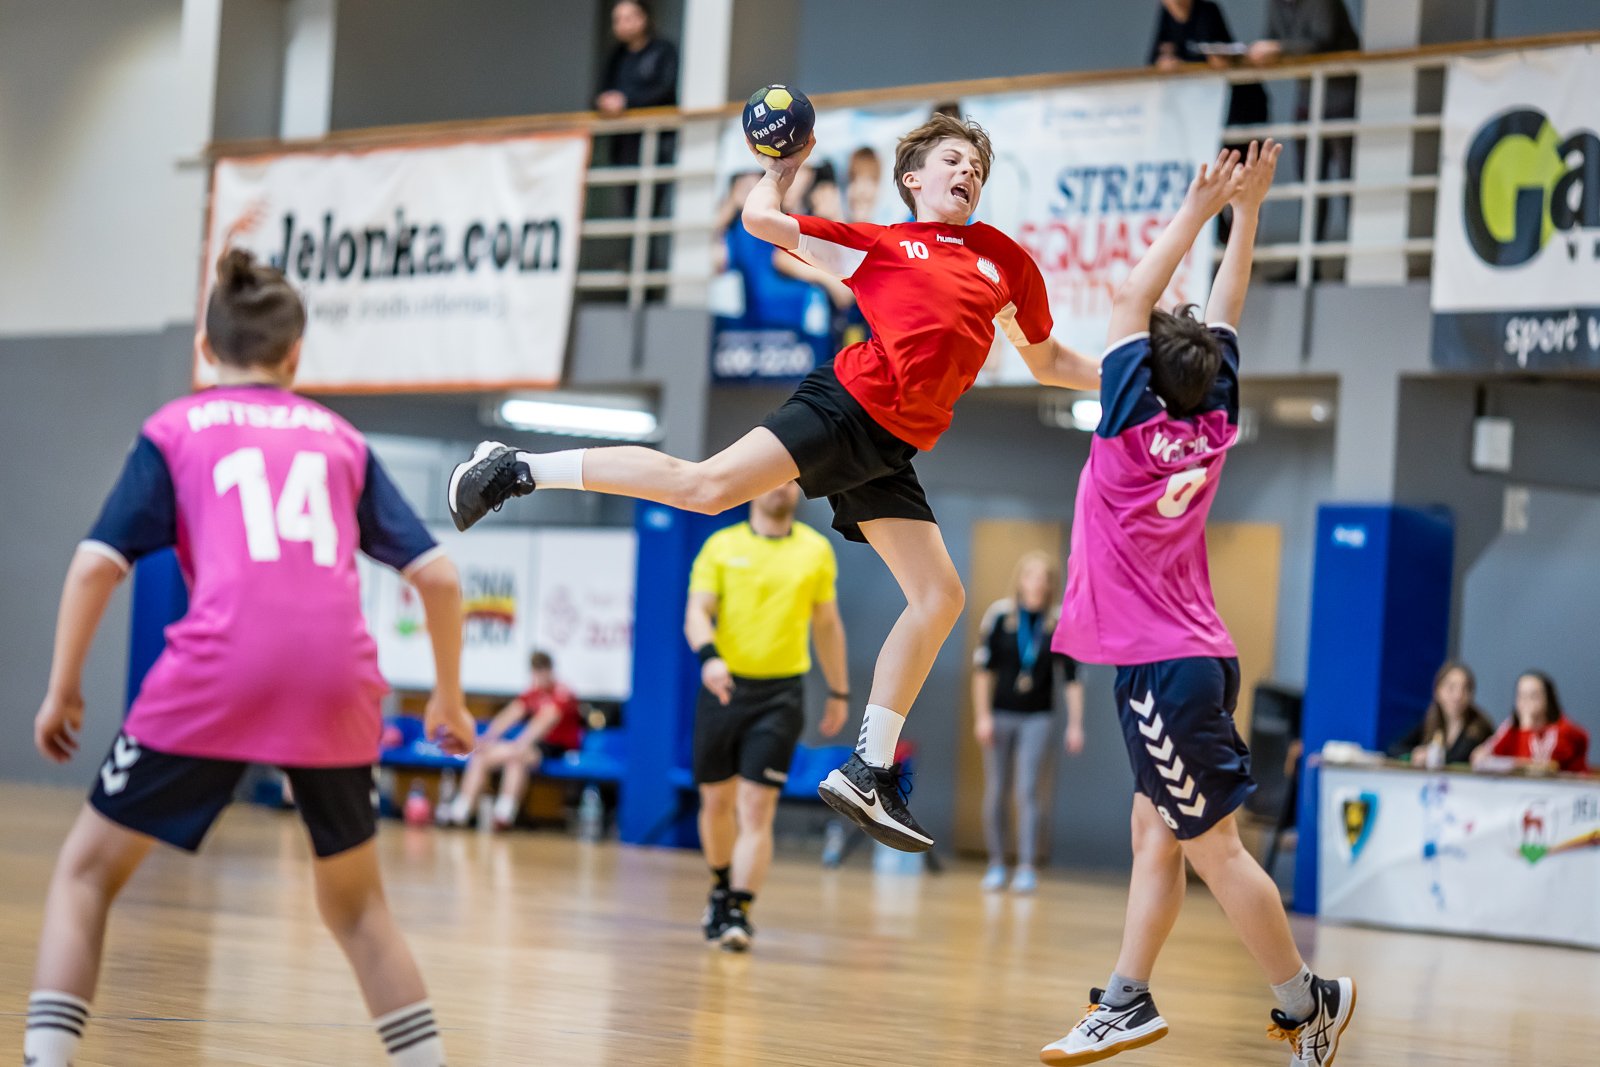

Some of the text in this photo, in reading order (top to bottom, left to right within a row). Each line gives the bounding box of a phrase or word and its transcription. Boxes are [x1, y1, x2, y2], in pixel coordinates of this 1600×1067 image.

[751, 115, 787, 140] ATORKA
[273, 206, 561, 280] Jelonka.com
[899, 240, 930, 260] 10
[936, 233, 964, 246] hummel
[1018, 217, 1195, 272] SQUAS
[1503, 309, 1580, 369] sport
[213, 446, 340, 568] 14
[1156, 466, 1208, 518] 0
[1157, 805, 1179, 830] 8
